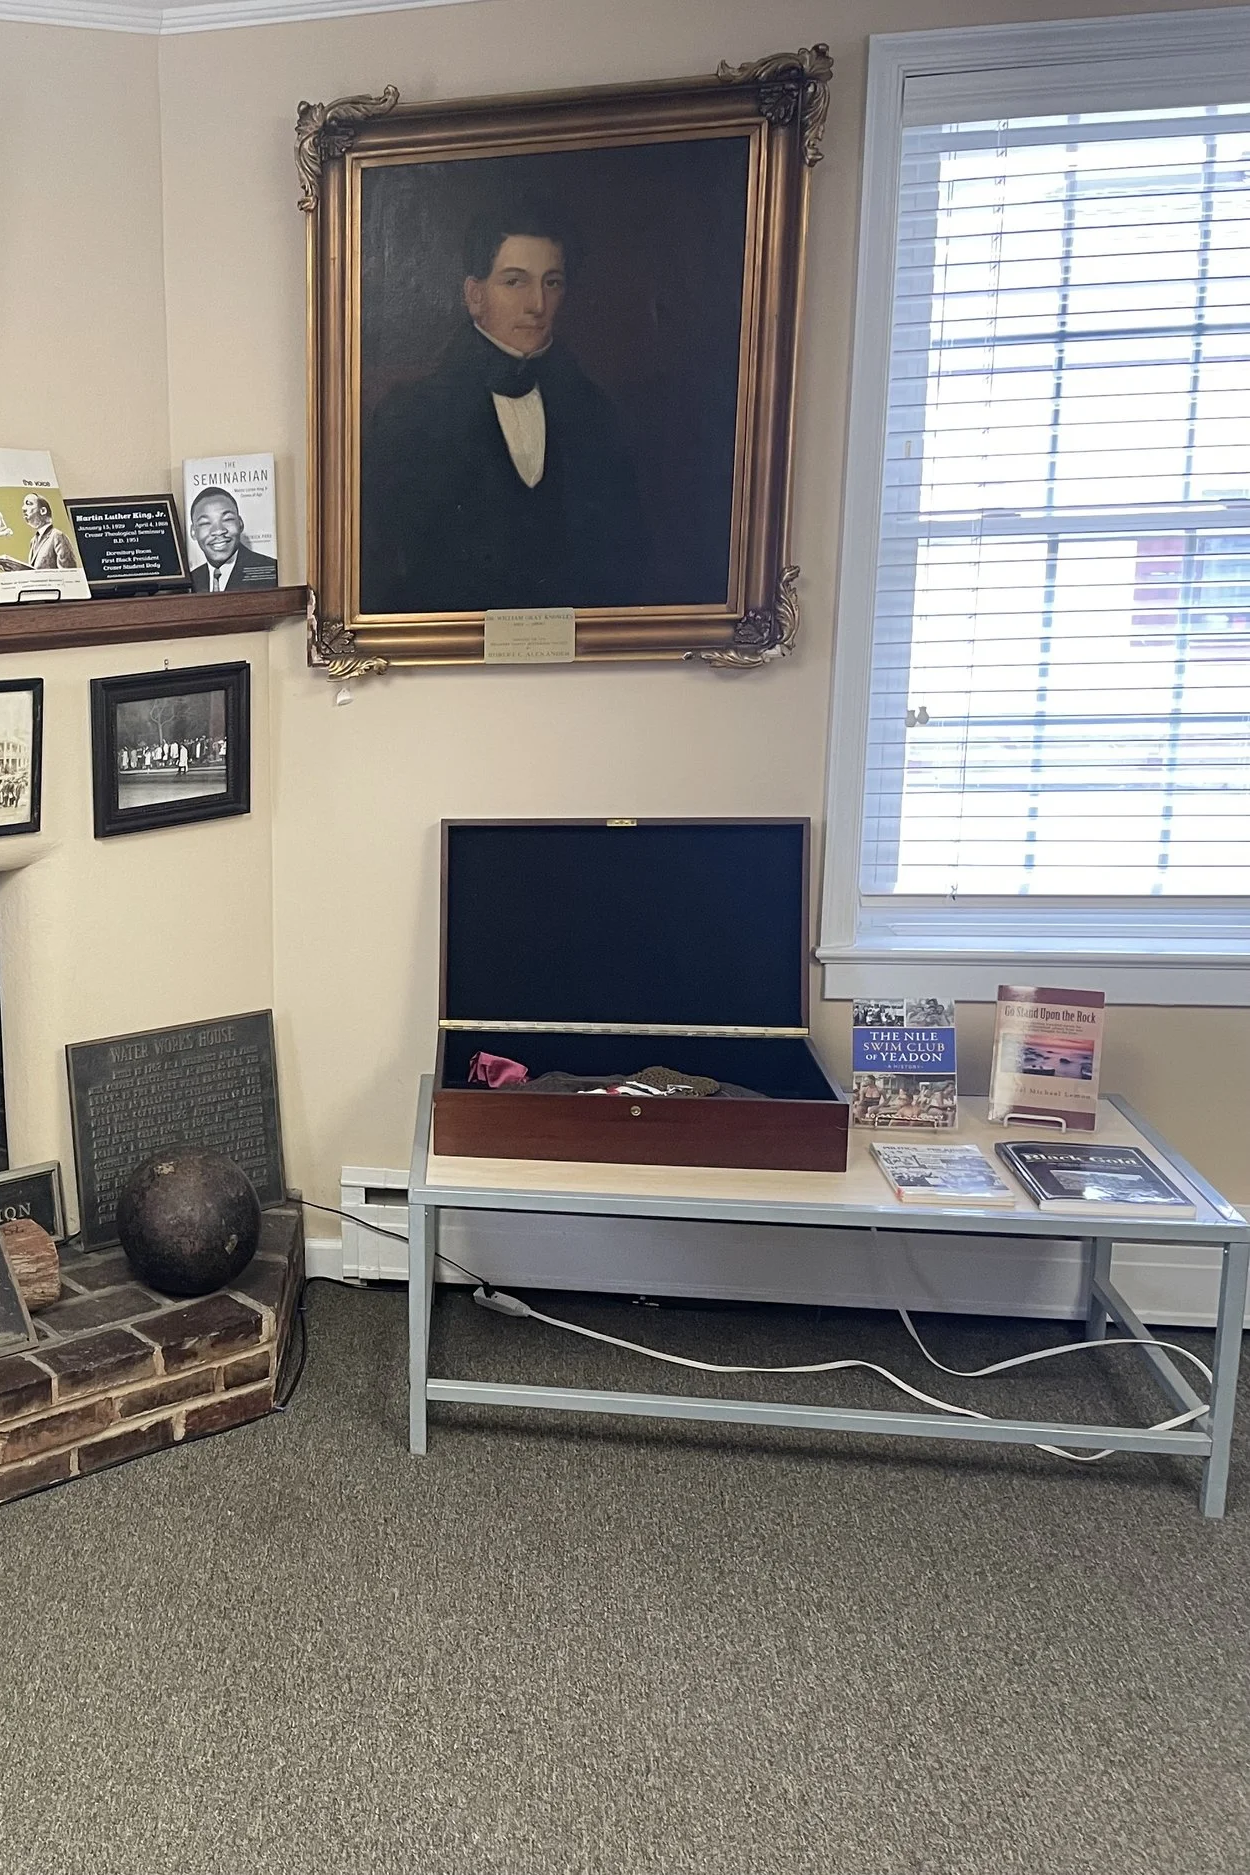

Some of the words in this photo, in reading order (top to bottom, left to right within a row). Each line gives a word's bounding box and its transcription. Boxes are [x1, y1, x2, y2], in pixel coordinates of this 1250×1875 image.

[224, 461, 236, 469] THE
[193, 469, 268, 486] SEMINARIAN
[22, 479, 33, 487] the
[76, 514, 103, 522] Martin
[104, 512, 131, 520] Luther
[155, 510, 166, 518] Jr.
[78, 524, 102, 532] January
[104, 530, 137, 538] Theological
[1005, 1005, 1015, 1017] Go
[1016, 1006, 1038, 1019] Stand
[1040, 1008, 1061, 1022] Upon
[1062, 1010, 1075, 1022] the
[1076, 1010, 1096, 1024] Rock
[870, 1031, 900, 1041] THE
[904, 1032, 938, 1041] NILE
[110, 1042, 149, 1063] WATER
[153, 1033, 194, 1055] WORKS
[199, 1026, 236, 1047] HOUSE
[863, 1042, 902, 1052] SWIM
[906, 1042, 945, 1052] CLUB
[880, 1052, 943, 1062] YEADON
[1021, 1152, 1083, 1163] Black
[1089, 1155, 1138, 1166] Gold
